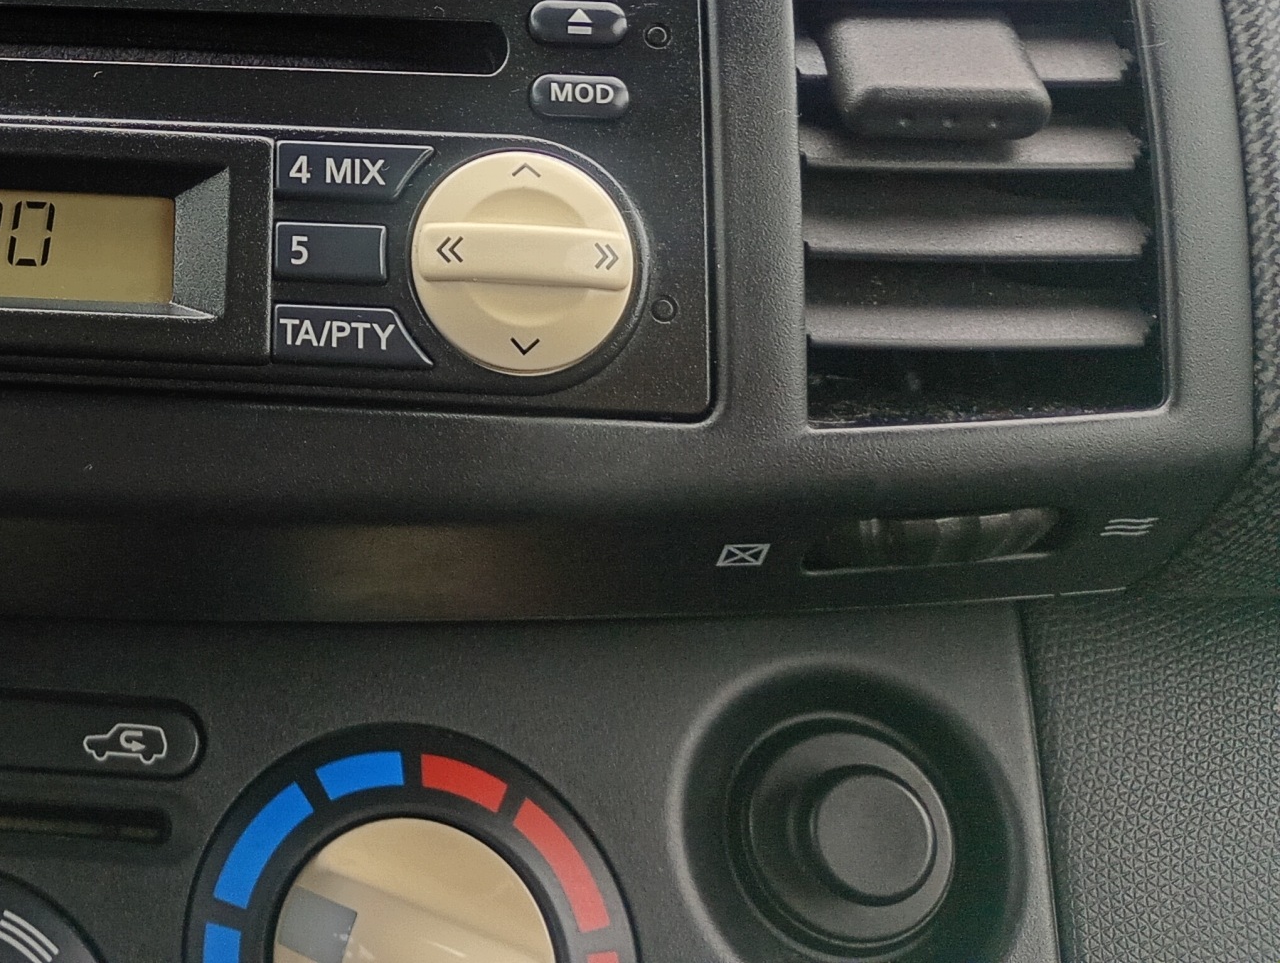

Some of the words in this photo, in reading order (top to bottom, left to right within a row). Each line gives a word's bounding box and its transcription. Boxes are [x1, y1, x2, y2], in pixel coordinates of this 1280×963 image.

[550, 82, 614, 104] MOD
[289, 155, 311, 184] 4
[325, 157, 386, 186] MIX
[290, 235, 309, 265] 5
[279, 318, 396, 351] TA/PTY
